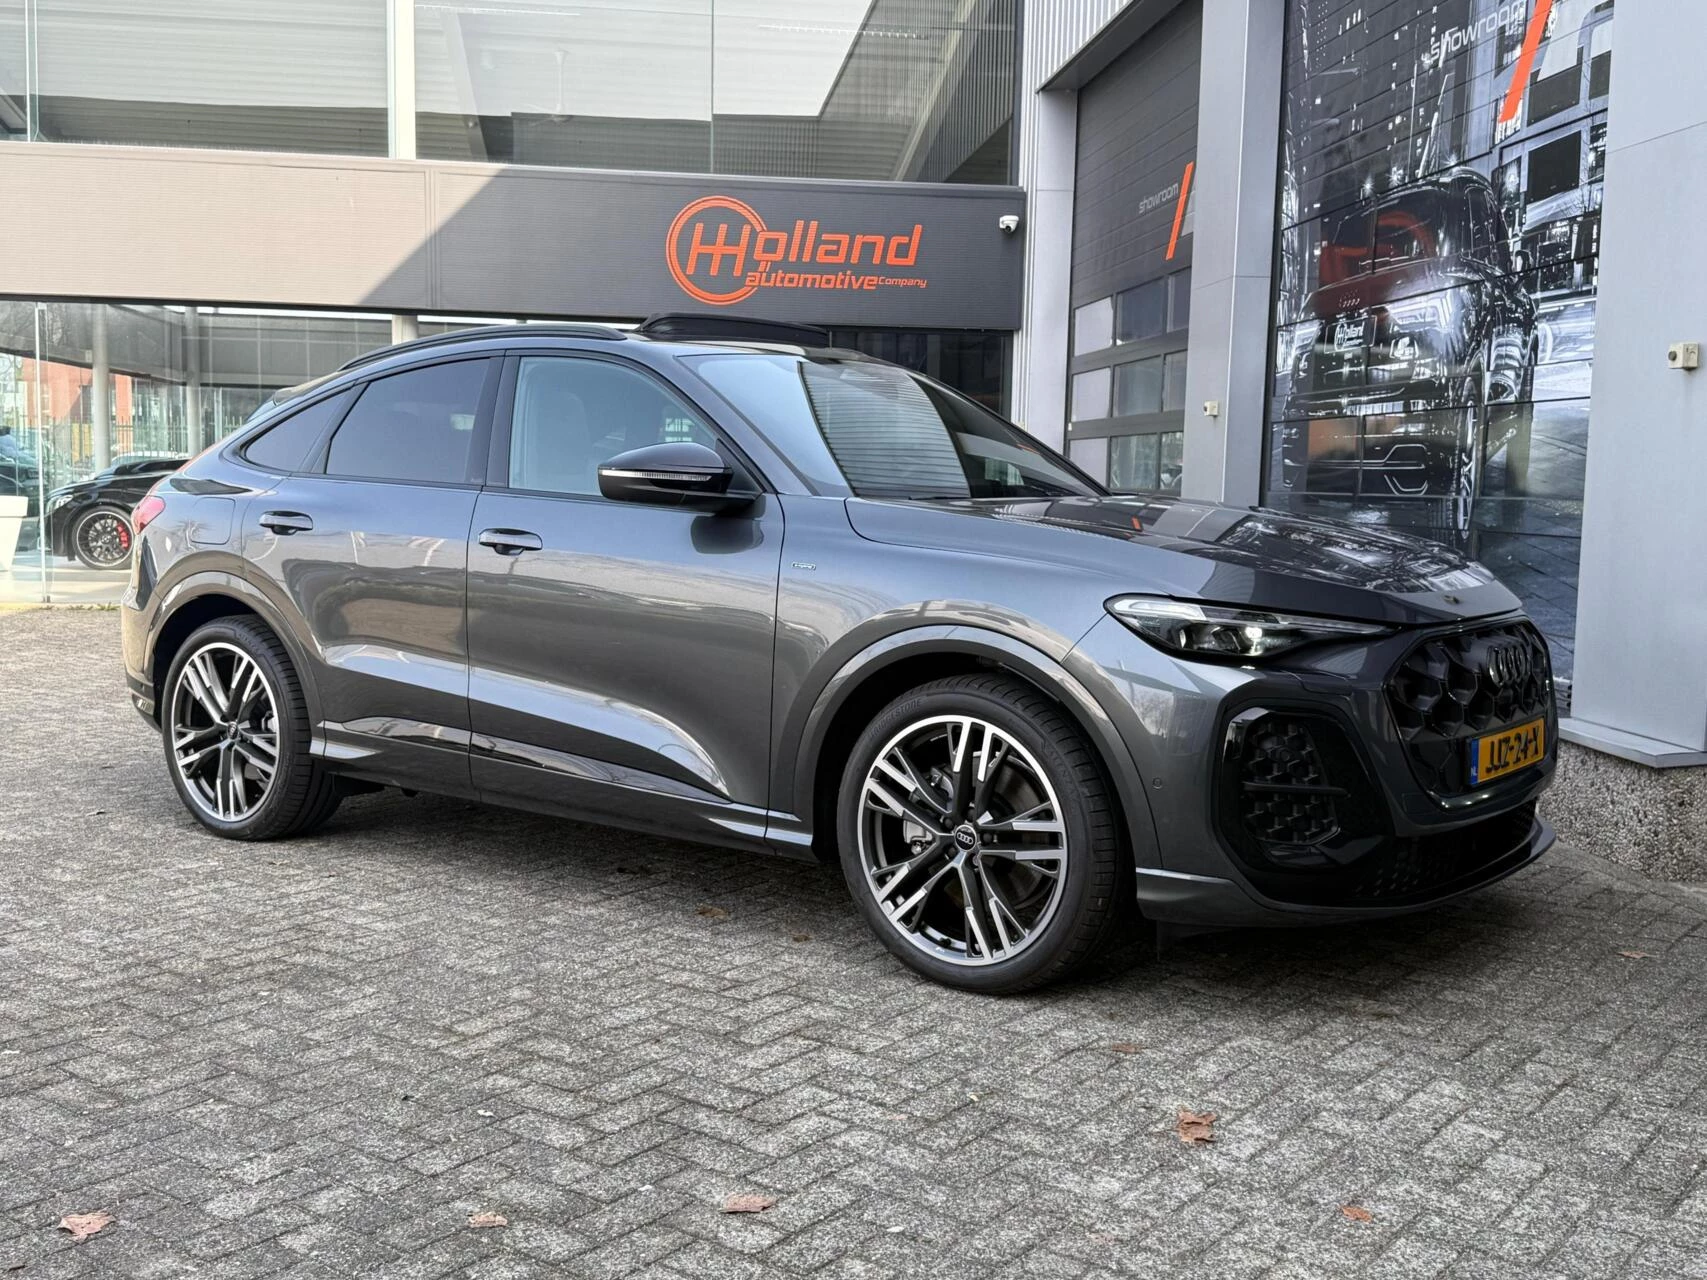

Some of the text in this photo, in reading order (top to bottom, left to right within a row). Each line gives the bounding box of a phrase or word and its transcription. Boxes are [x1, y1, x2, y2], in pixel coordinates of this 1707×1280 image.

[1138, 182, 1179, 214] showroom
[685, 219, 923, 277] Holland
[744, 270, 928, 290] automotive Company
